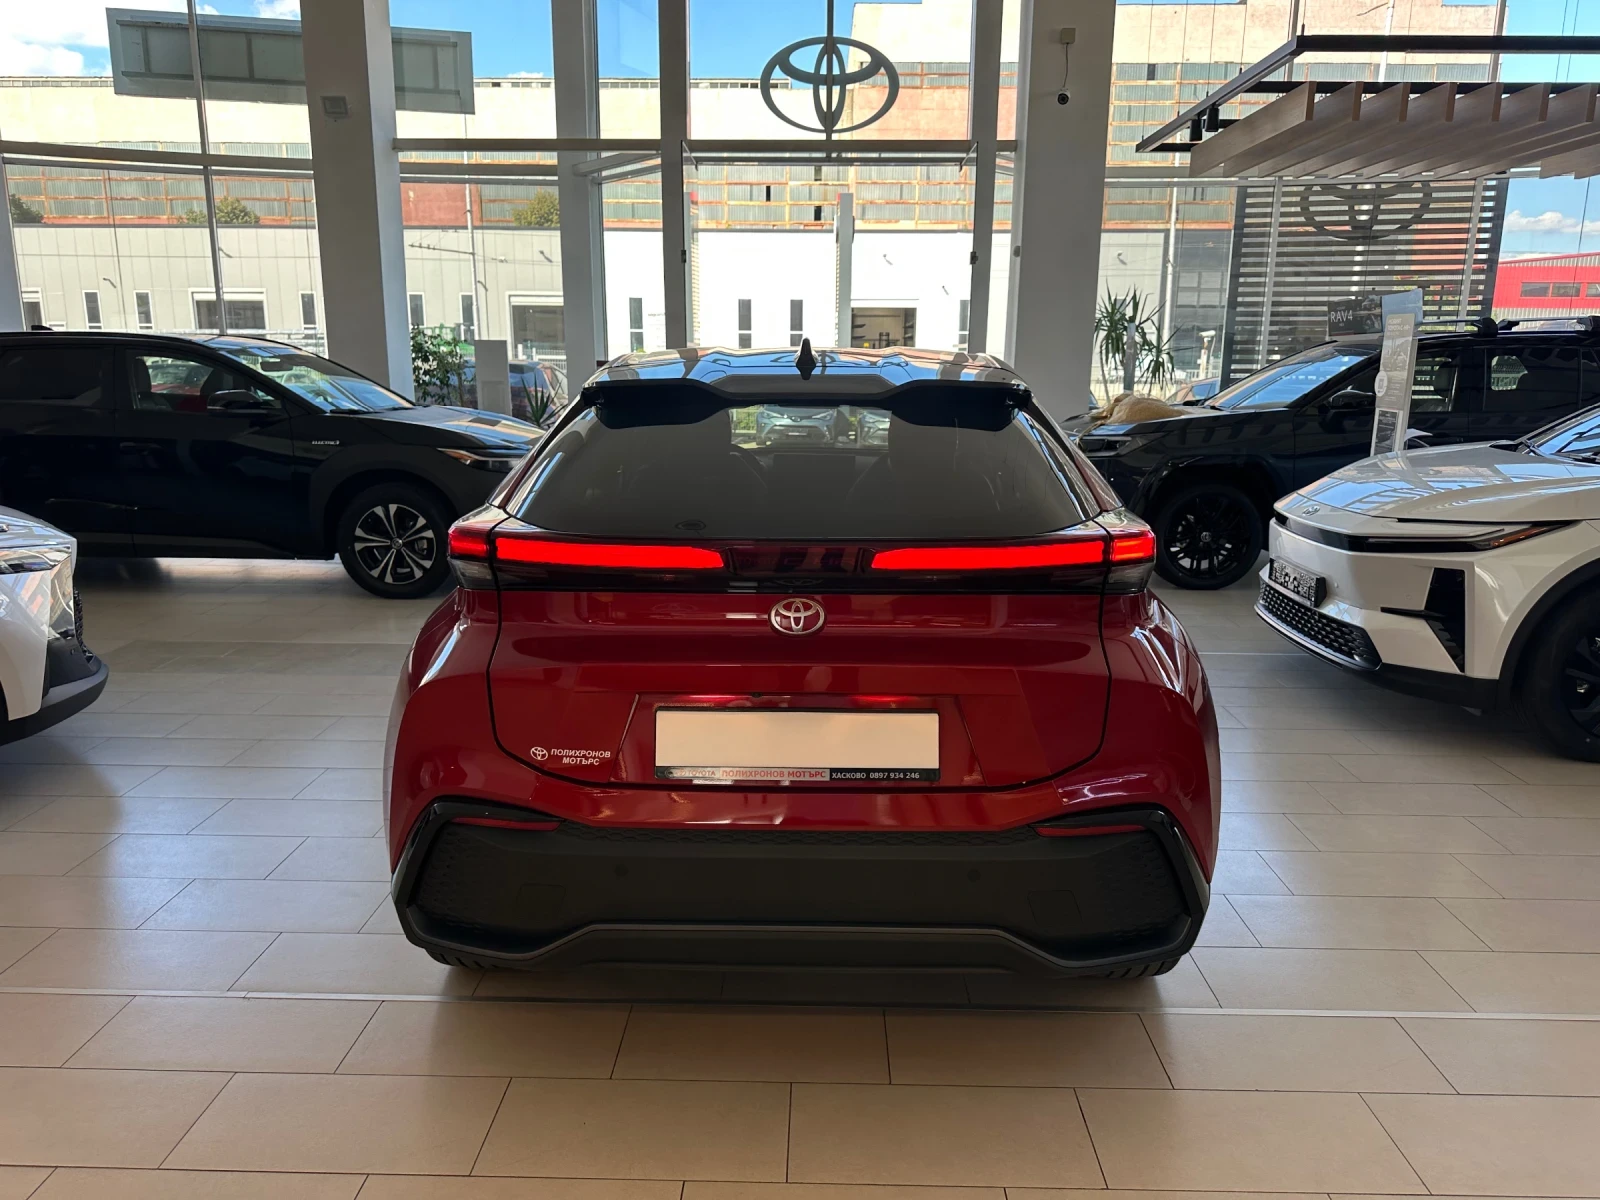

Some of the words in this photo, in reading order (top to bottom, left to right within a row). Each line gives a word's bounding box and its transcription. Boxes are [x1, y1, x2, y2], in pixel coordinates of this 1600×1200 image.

[1330, 309, 1354, 323] RAV4
[551, 748, 611, 758] ПОЛИХРОНОВ
[562, 756, 600, 765] МОТЪРС
[721, 769, 785, 778] ПОЛИХРОНОВ
[787, 770, 827, 778] МОТЪРС
[831, 771, 867, 779] ХАСКОВО
[869, 771, 888, 779] 0897
[889, 771, 904, 779] 934
